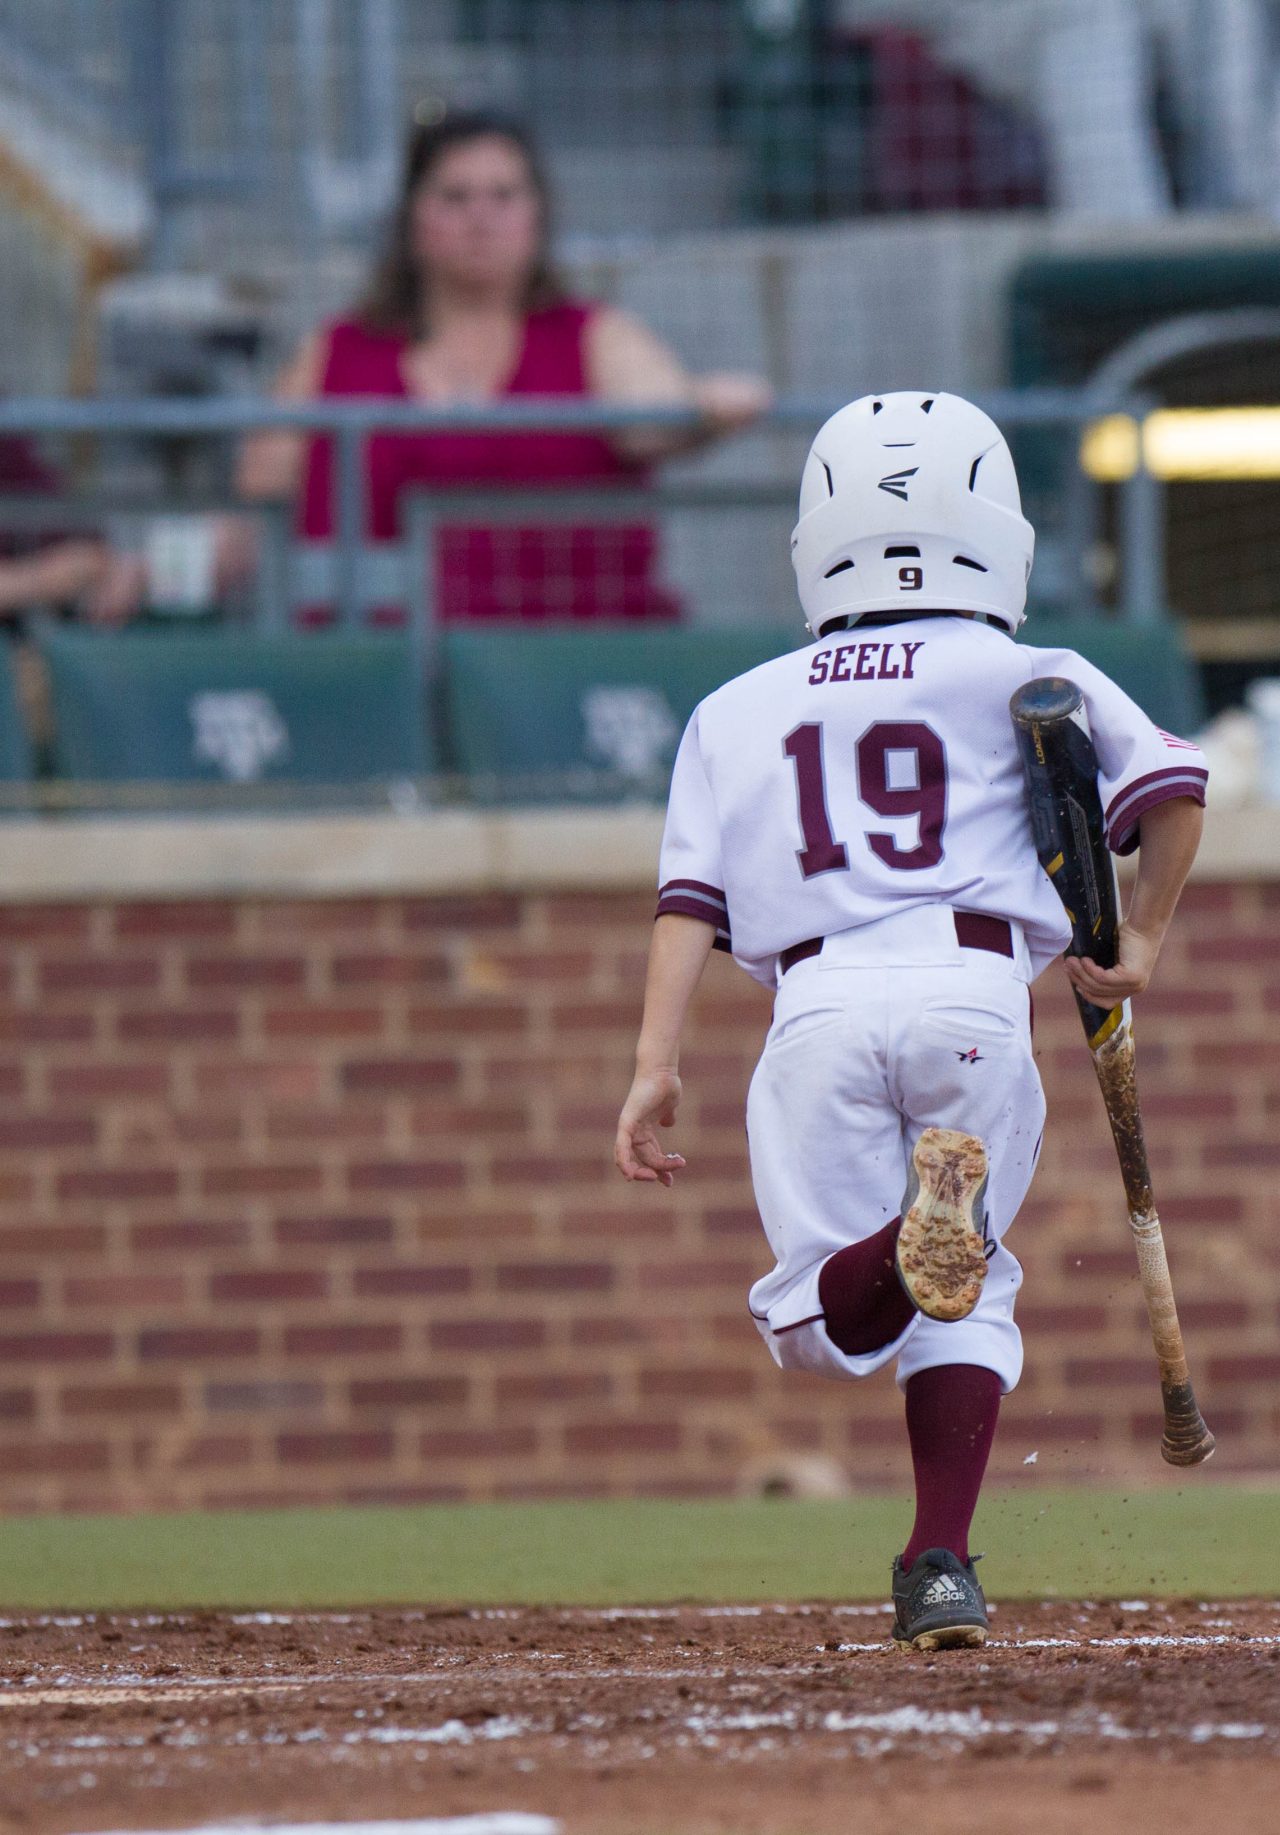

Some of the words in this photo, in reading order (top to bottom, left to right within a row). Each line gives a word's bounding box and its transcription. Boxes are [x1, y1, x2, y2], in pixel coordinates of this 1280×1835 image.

[899, 567, 923, 590] 9
[808, 642, 925, 685] SEELY
[781, 719, 950, 881] 19
[922, 1590, 966, 1605] adidas
